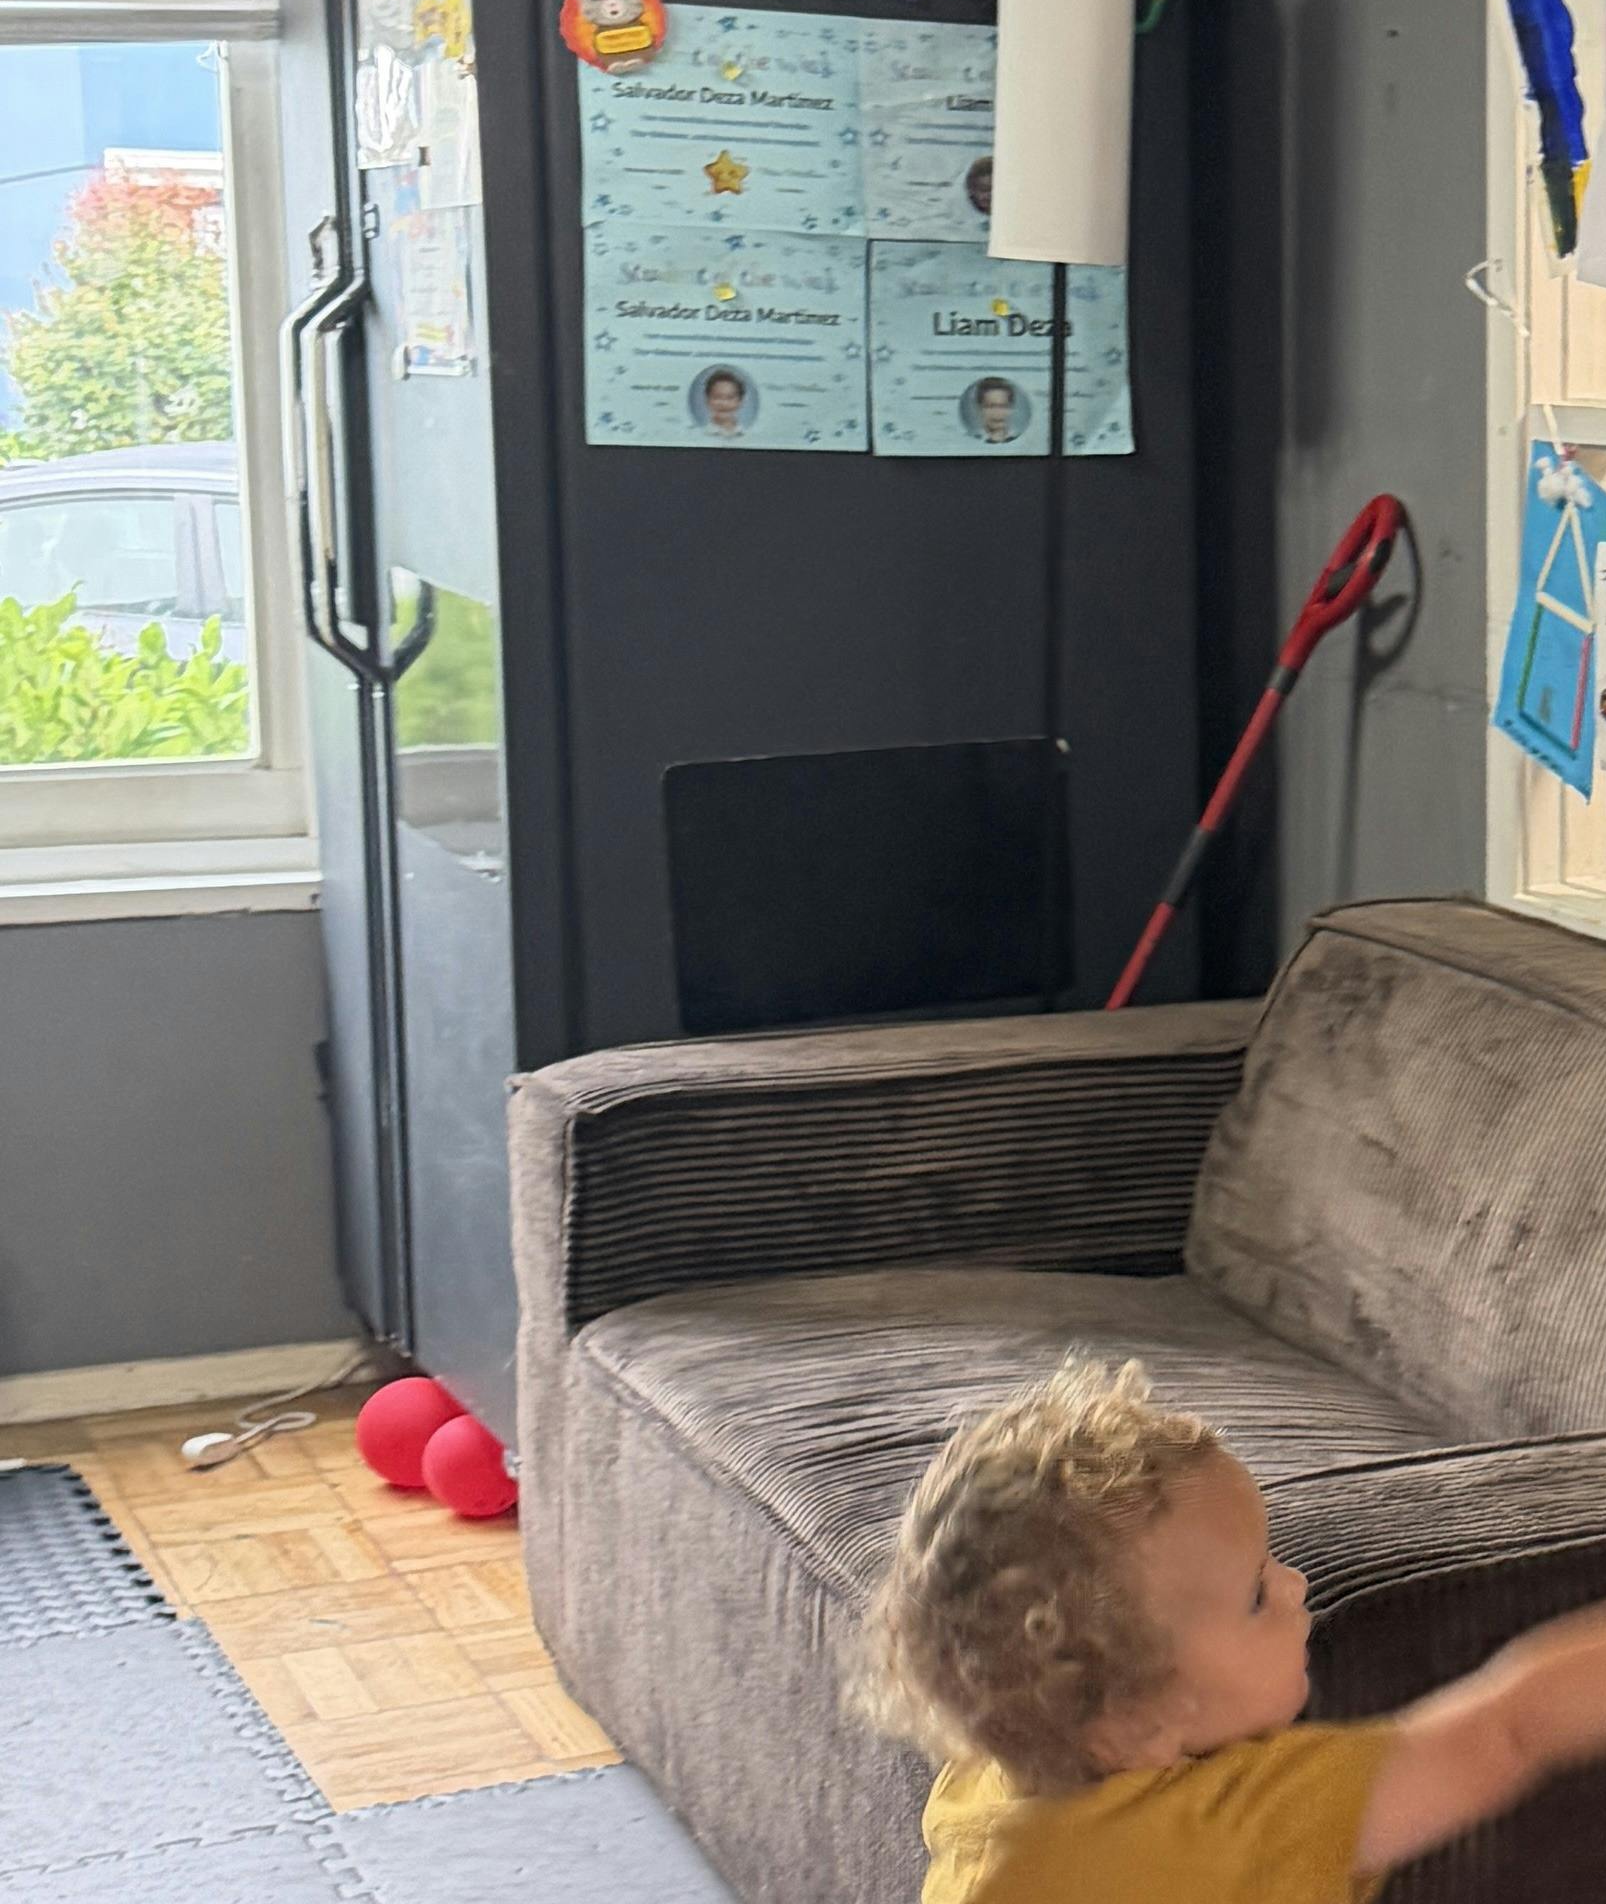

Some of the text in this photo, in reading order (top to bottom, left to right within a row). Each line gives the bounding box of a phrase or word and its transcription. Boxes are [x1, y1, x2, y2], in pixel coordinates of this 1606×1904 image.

[611, 81, 697, 102] Salvador
[615, 300, 701, 319] Salvador
[932, 311, 999, 337] Liam
